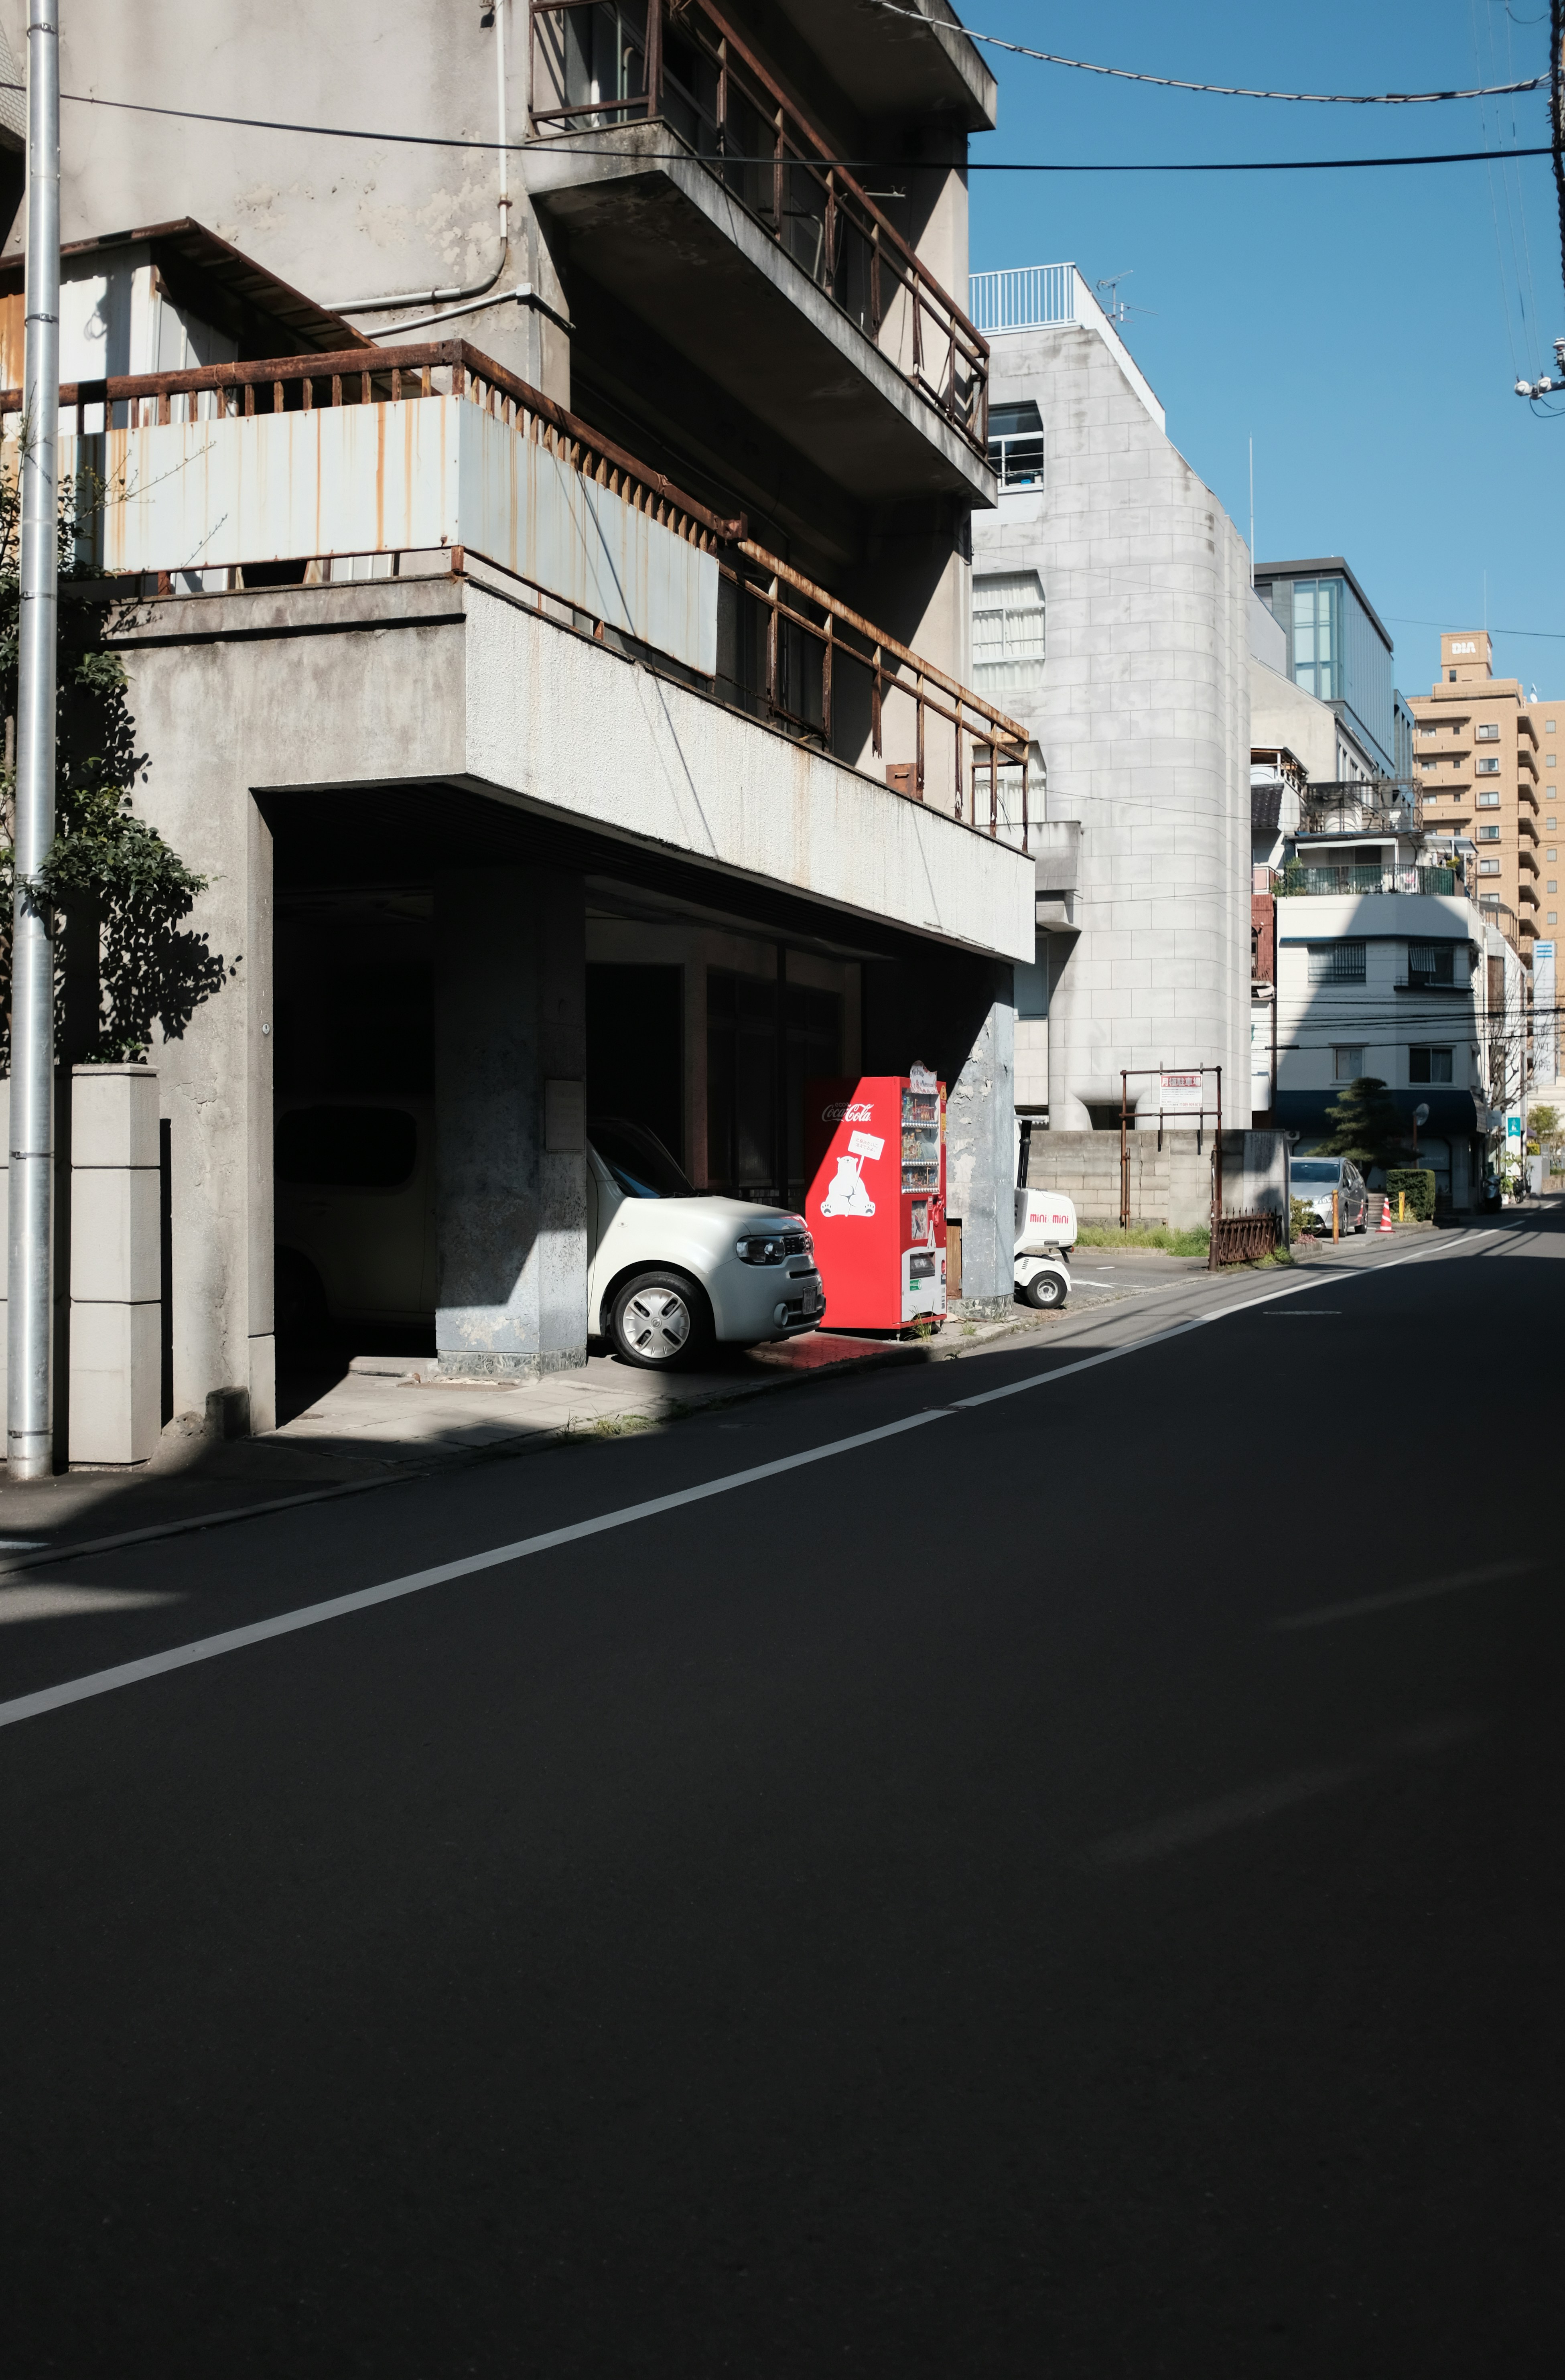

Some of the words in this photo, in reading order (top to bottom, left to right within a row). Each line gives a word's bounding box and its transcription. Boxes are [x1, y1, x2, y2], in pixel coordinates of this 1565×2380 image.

[1452, 642, 1476, 654] DIA
[912, 1067, 924, 1078] Welcome
[821, 1104, 874, 1123] Coca-Cola
[1030, 1214, 1047, 1223] mini
[1052, 1214, 1069, 1224] mini
